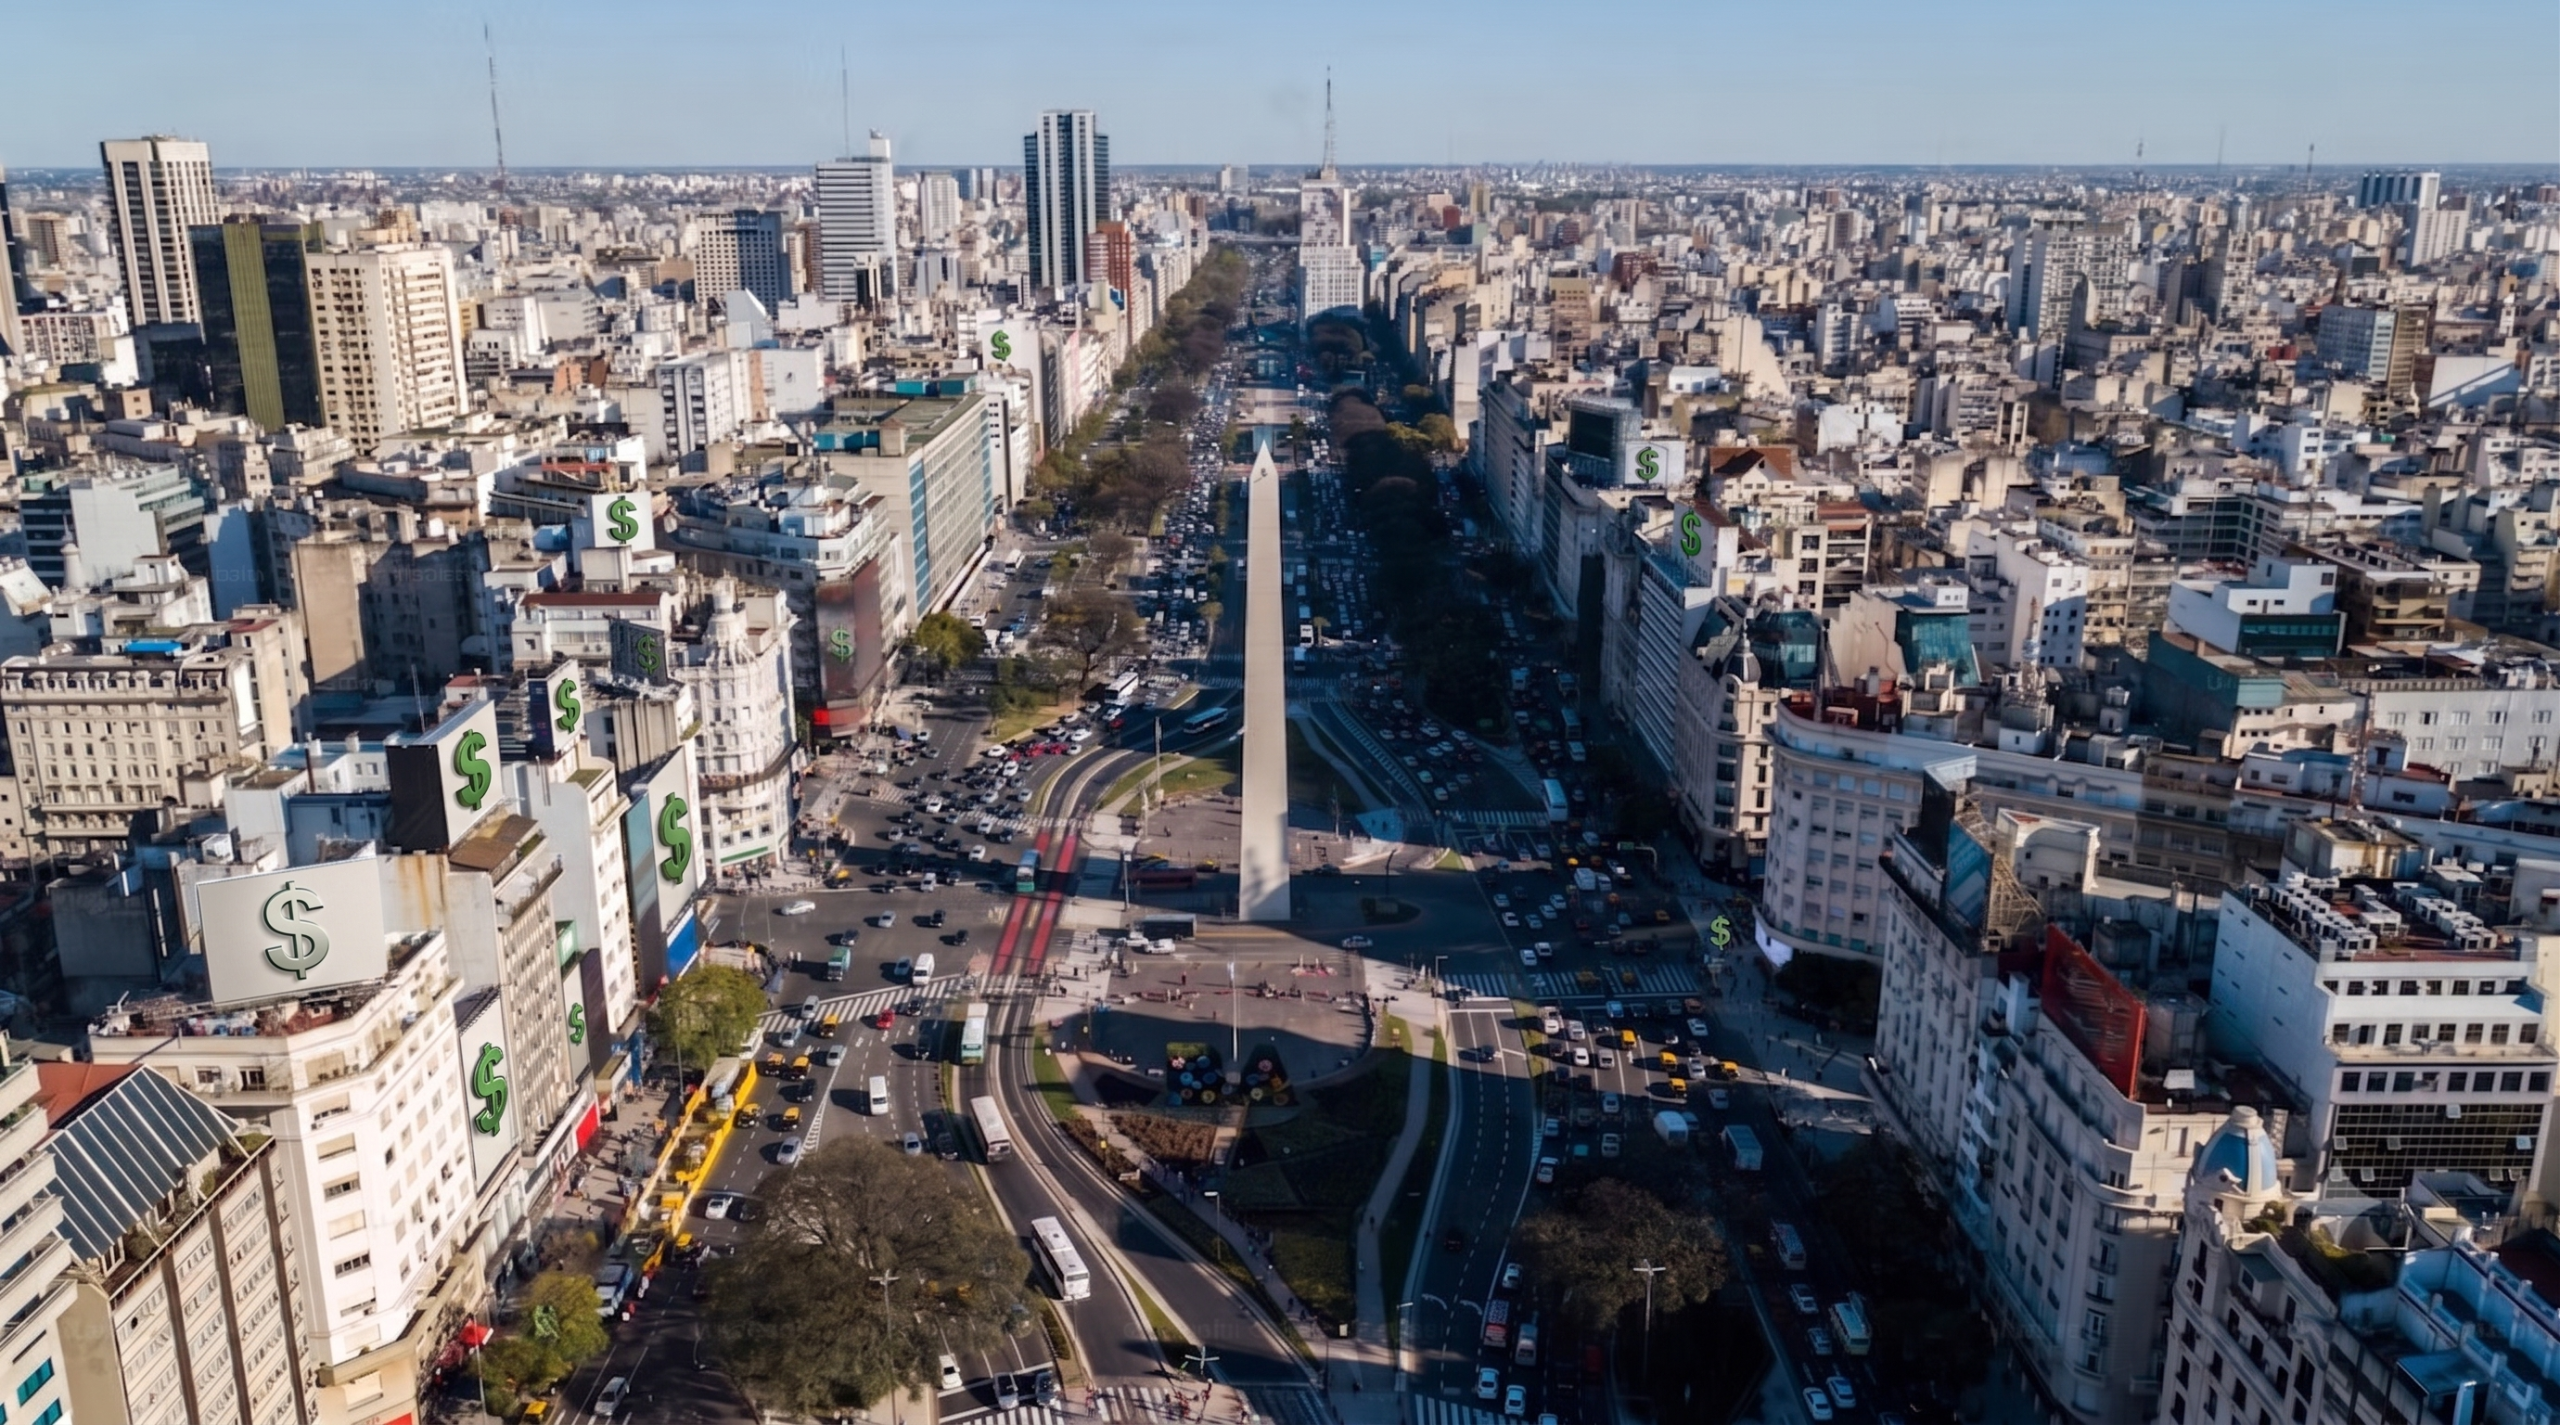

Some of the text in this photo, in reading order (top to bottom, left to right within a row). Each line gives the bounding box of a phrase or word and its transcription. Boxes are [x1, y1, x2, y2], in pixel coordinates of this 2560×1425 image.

[992, 330, 1011, 360] $
[1636, 447, 1659, 480] $
[608, 496, 639, 543] $
[1680, 510, 1702, 557] $
[637, 634, 661, 675] $
[830, 625, 854, 664] $
[556, 678, 581, 734] $
[454, 728, 493, 810] $
[658, 791, 692, 885] $
[263, 880, 330, 980] $
[1710, 915, 1731, 949] $
[568, 1002, 586, 1044] $
[473, 1043, 509, 1136] $
